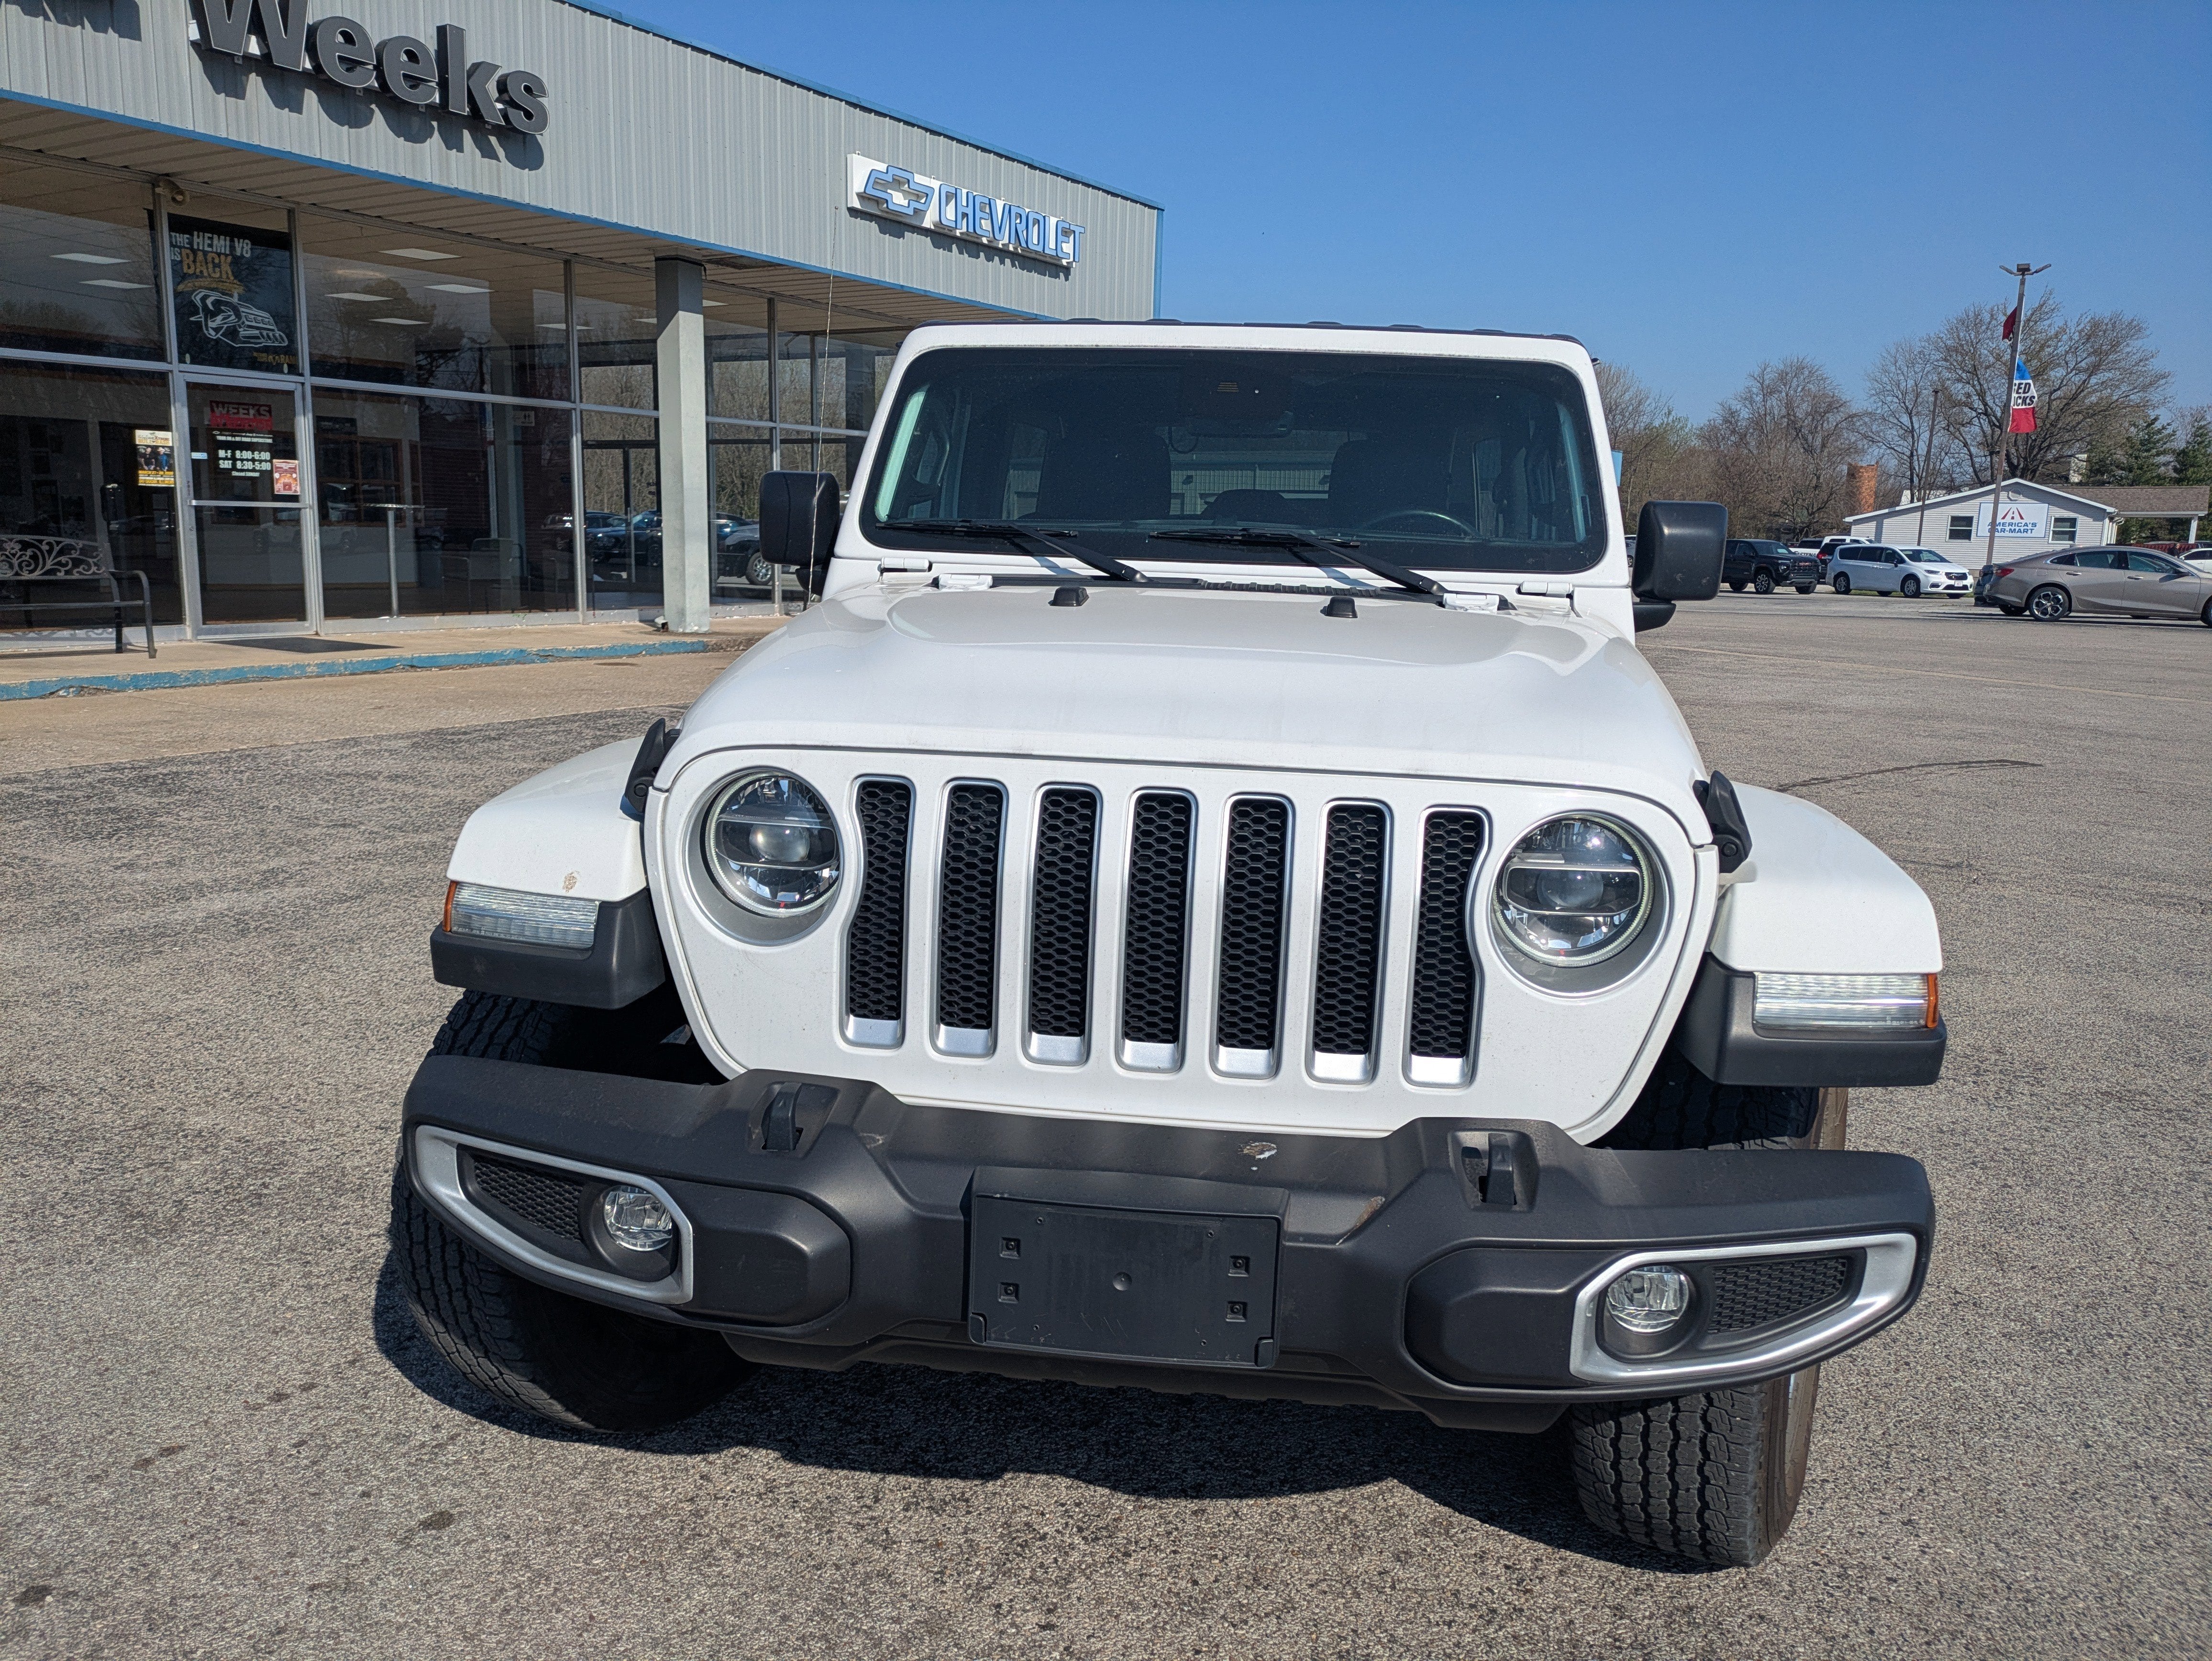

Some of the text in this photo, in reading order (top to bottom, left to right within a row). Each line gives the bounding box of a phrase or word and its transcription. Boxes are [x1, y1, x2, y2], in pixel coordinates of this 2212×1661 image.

[197, 0, 550, 135] Weeks
[939, 183, 1085, 262] CHEVROLET
[170, 231, 251, 257] THE HEMI V8
[170, 247, 234, 280] IS BACK
[212, 403, 270, 419] WEEKS
[218, 450, 232, 458] M-F
[235, 450, 270, 460] 8:00-6:00
[219, 460, 232, 469] SAT
[236, 461, 271, 470] 8:30-5:00
